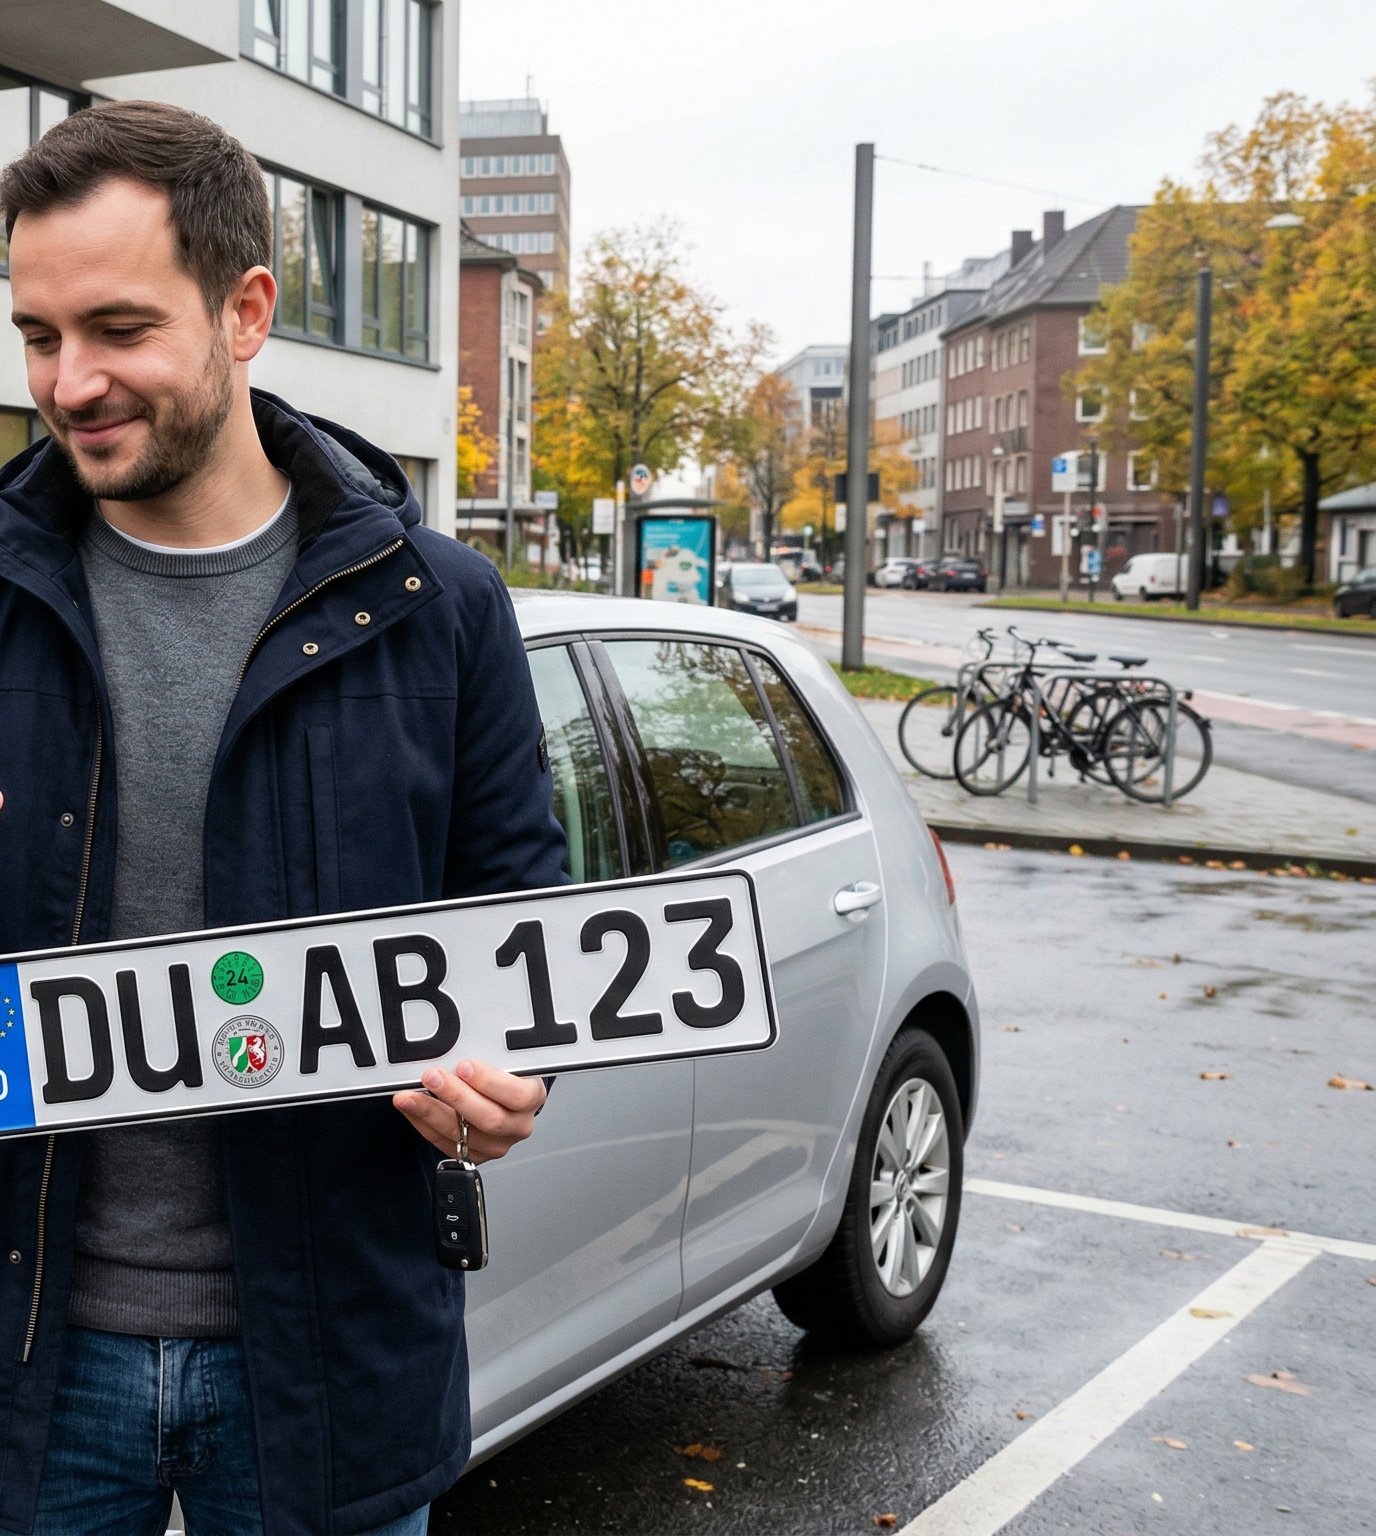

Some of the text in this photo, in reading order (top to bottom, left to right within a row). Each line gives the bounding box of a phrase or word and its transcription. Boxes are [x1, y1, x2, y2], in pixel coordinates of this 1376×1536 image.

[29, 962, 203, 1105] DU
[299, 933, 462, 1076] AB
[493, 896, 746, 1052] 123
[226, 968, 249, 987] 24
